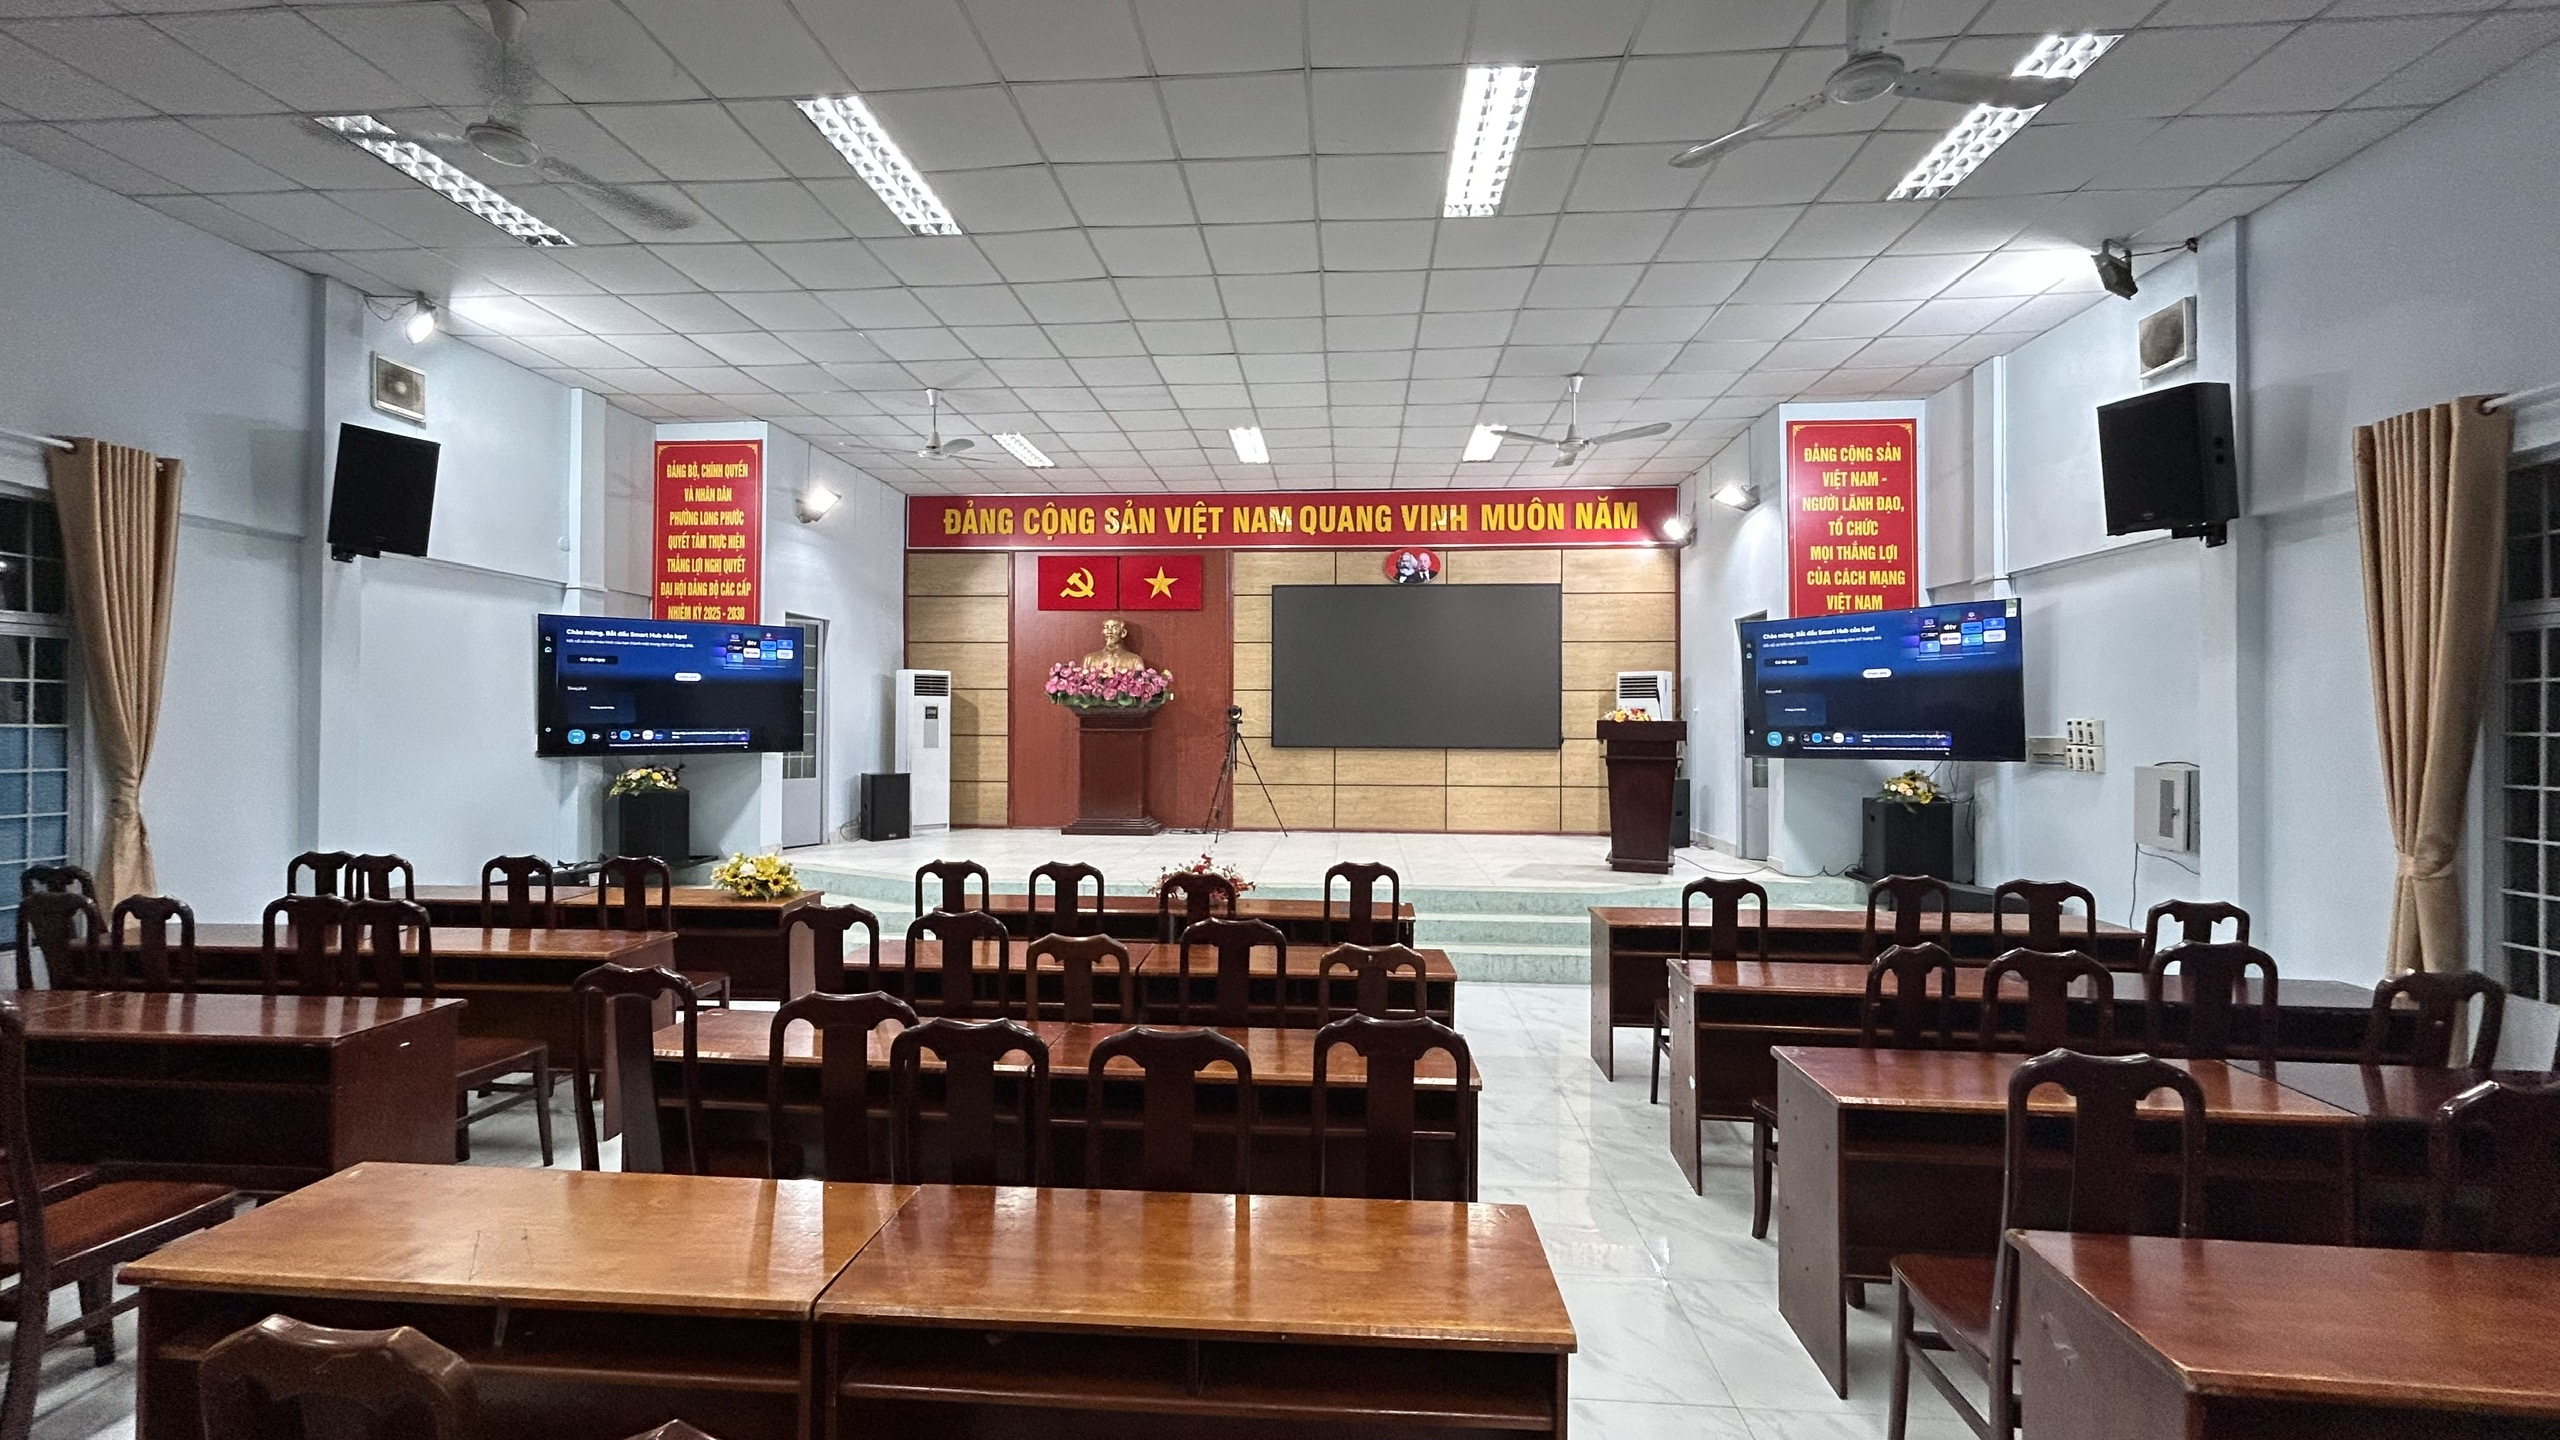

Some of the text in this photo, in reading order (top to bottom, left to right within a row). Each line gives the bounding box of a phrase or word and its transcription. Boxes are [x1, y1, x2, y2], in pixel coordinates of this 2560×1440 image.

[1803, 441, 1902, 465] ĐẢNG CỘNG SẢN
[666, 460, 687, 478] ĐẢNG
[688, 461, 700, 481] BỘ,
[701, 461, 724, 478] CHÍNH
[1822, 468, 1848, 490] VIỆT
[1850, 471, 1879, 487] NAM
[684, 485, 732, 502] VÀ NHÂN DÂN
[1802, 493, 1904, 513] NGƯỜI LÃNH ĐẠO,
[669, 508, 745, 526] PHƯỜNG LONG PHƯỚC
[943, 496, 1638, 541] ĐẢNG CỘNG SẢN VIỆT NAM QUANG VINH MUÔN NĂM
[1828, 515, 1879, 536] TỔ CHỨC
[668, 531, 745, 551] QUYẾT TÂM THỰC HIỆN
[1810, 540, 1898, 563] MỌI THẮNG LỢI
[667, 553, 746, 575] THẮNG LỢI NGHỊ QUYẾT
[1807, 566, 1906, 588] CỦA CÁCH MẠNG
[661, 578, 751, 599] ĐẠI HỘI ĐẢNG BỘ CÁC CẤP
[1826, 592, 1883, 613] VIỆT NAM
[703, 606, 721, 621] 2025
[727, 606, 745, 621] 2030
